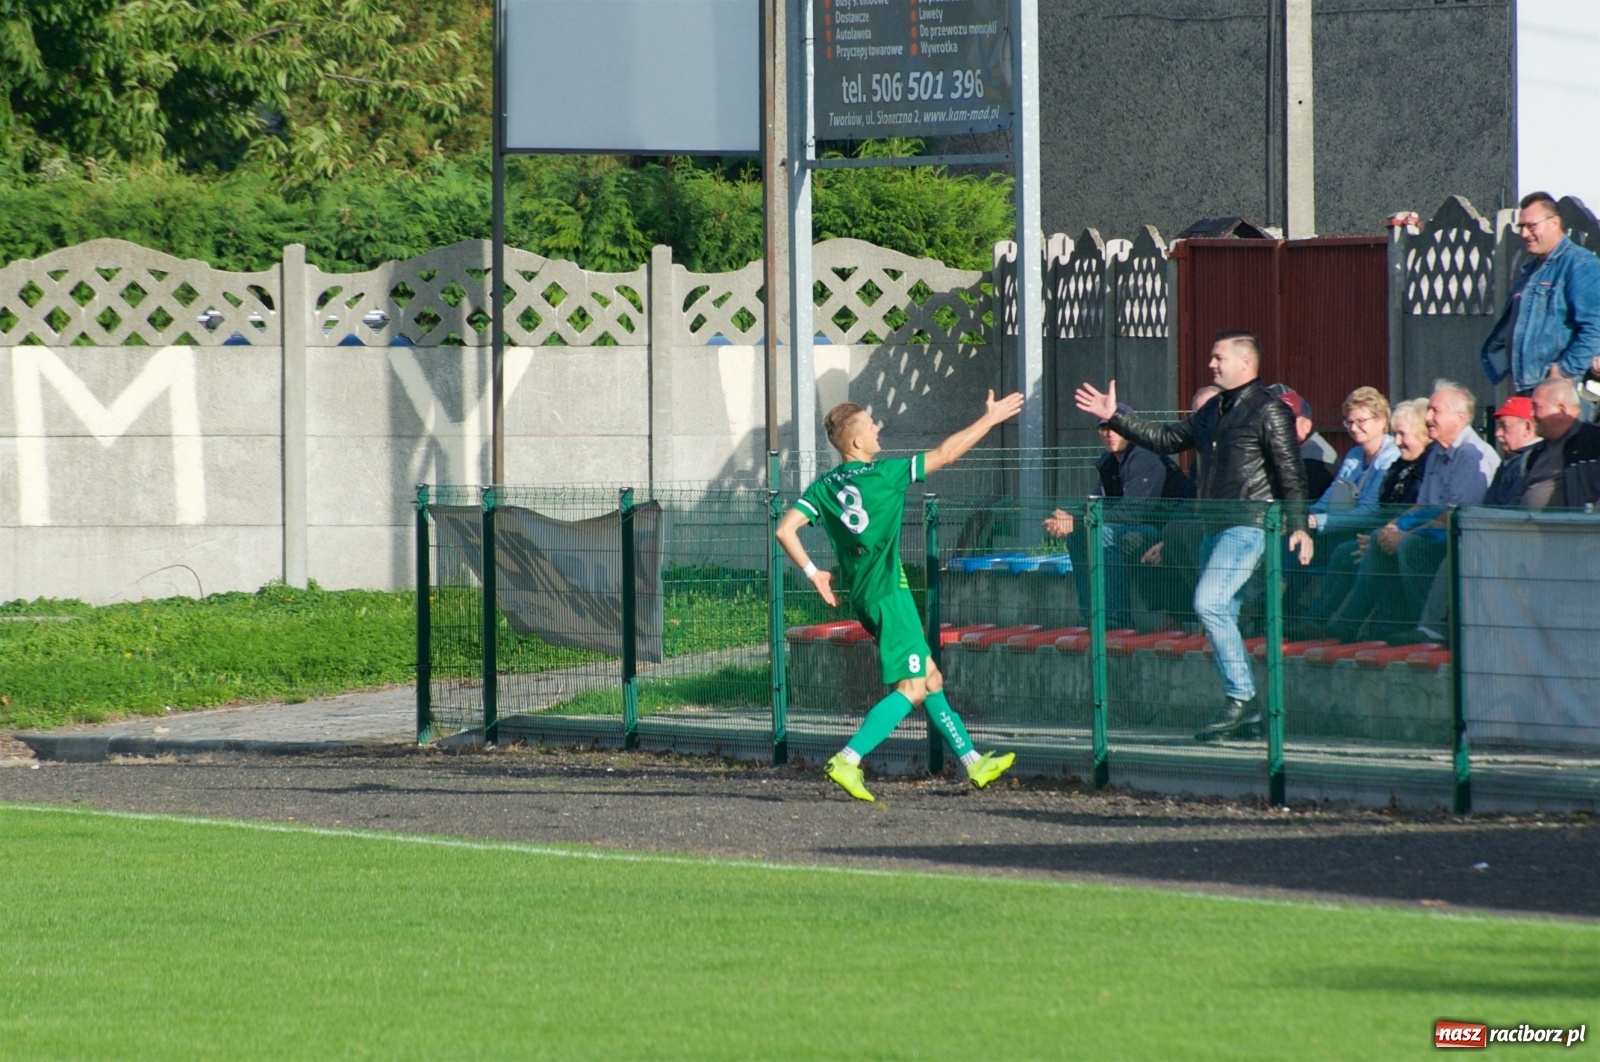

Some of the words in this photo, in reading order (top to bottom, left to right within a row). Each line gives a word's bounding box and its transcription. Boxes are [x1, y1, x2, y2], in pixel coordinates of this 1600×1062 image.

[835, 11, 869, 24] Dostawcze
[919, 7, 943, 23] Lawety
[836, 28, 872, 41] Autolaweta
[920, 24, 929, 38] Do
[930, 25, 968, 40] przewozu
[836, 45, 868, 61] Przyczepy
[868, 45, 904, 57] towarowe
[921, 40, 958, 58] Wywrotka
[842, 73, 867, 104] tel.
[872, 72, 903, 103] 506
[907, 71, 944, 101] 501
[950, 69, 984, 99] 396
[829, 112, 865, 128] Tworków,
[923, 104, 1000, 124] www.kam-mad.pl
[836, 485, 870, 535] 8
[908, 654, 921, 673] 8
